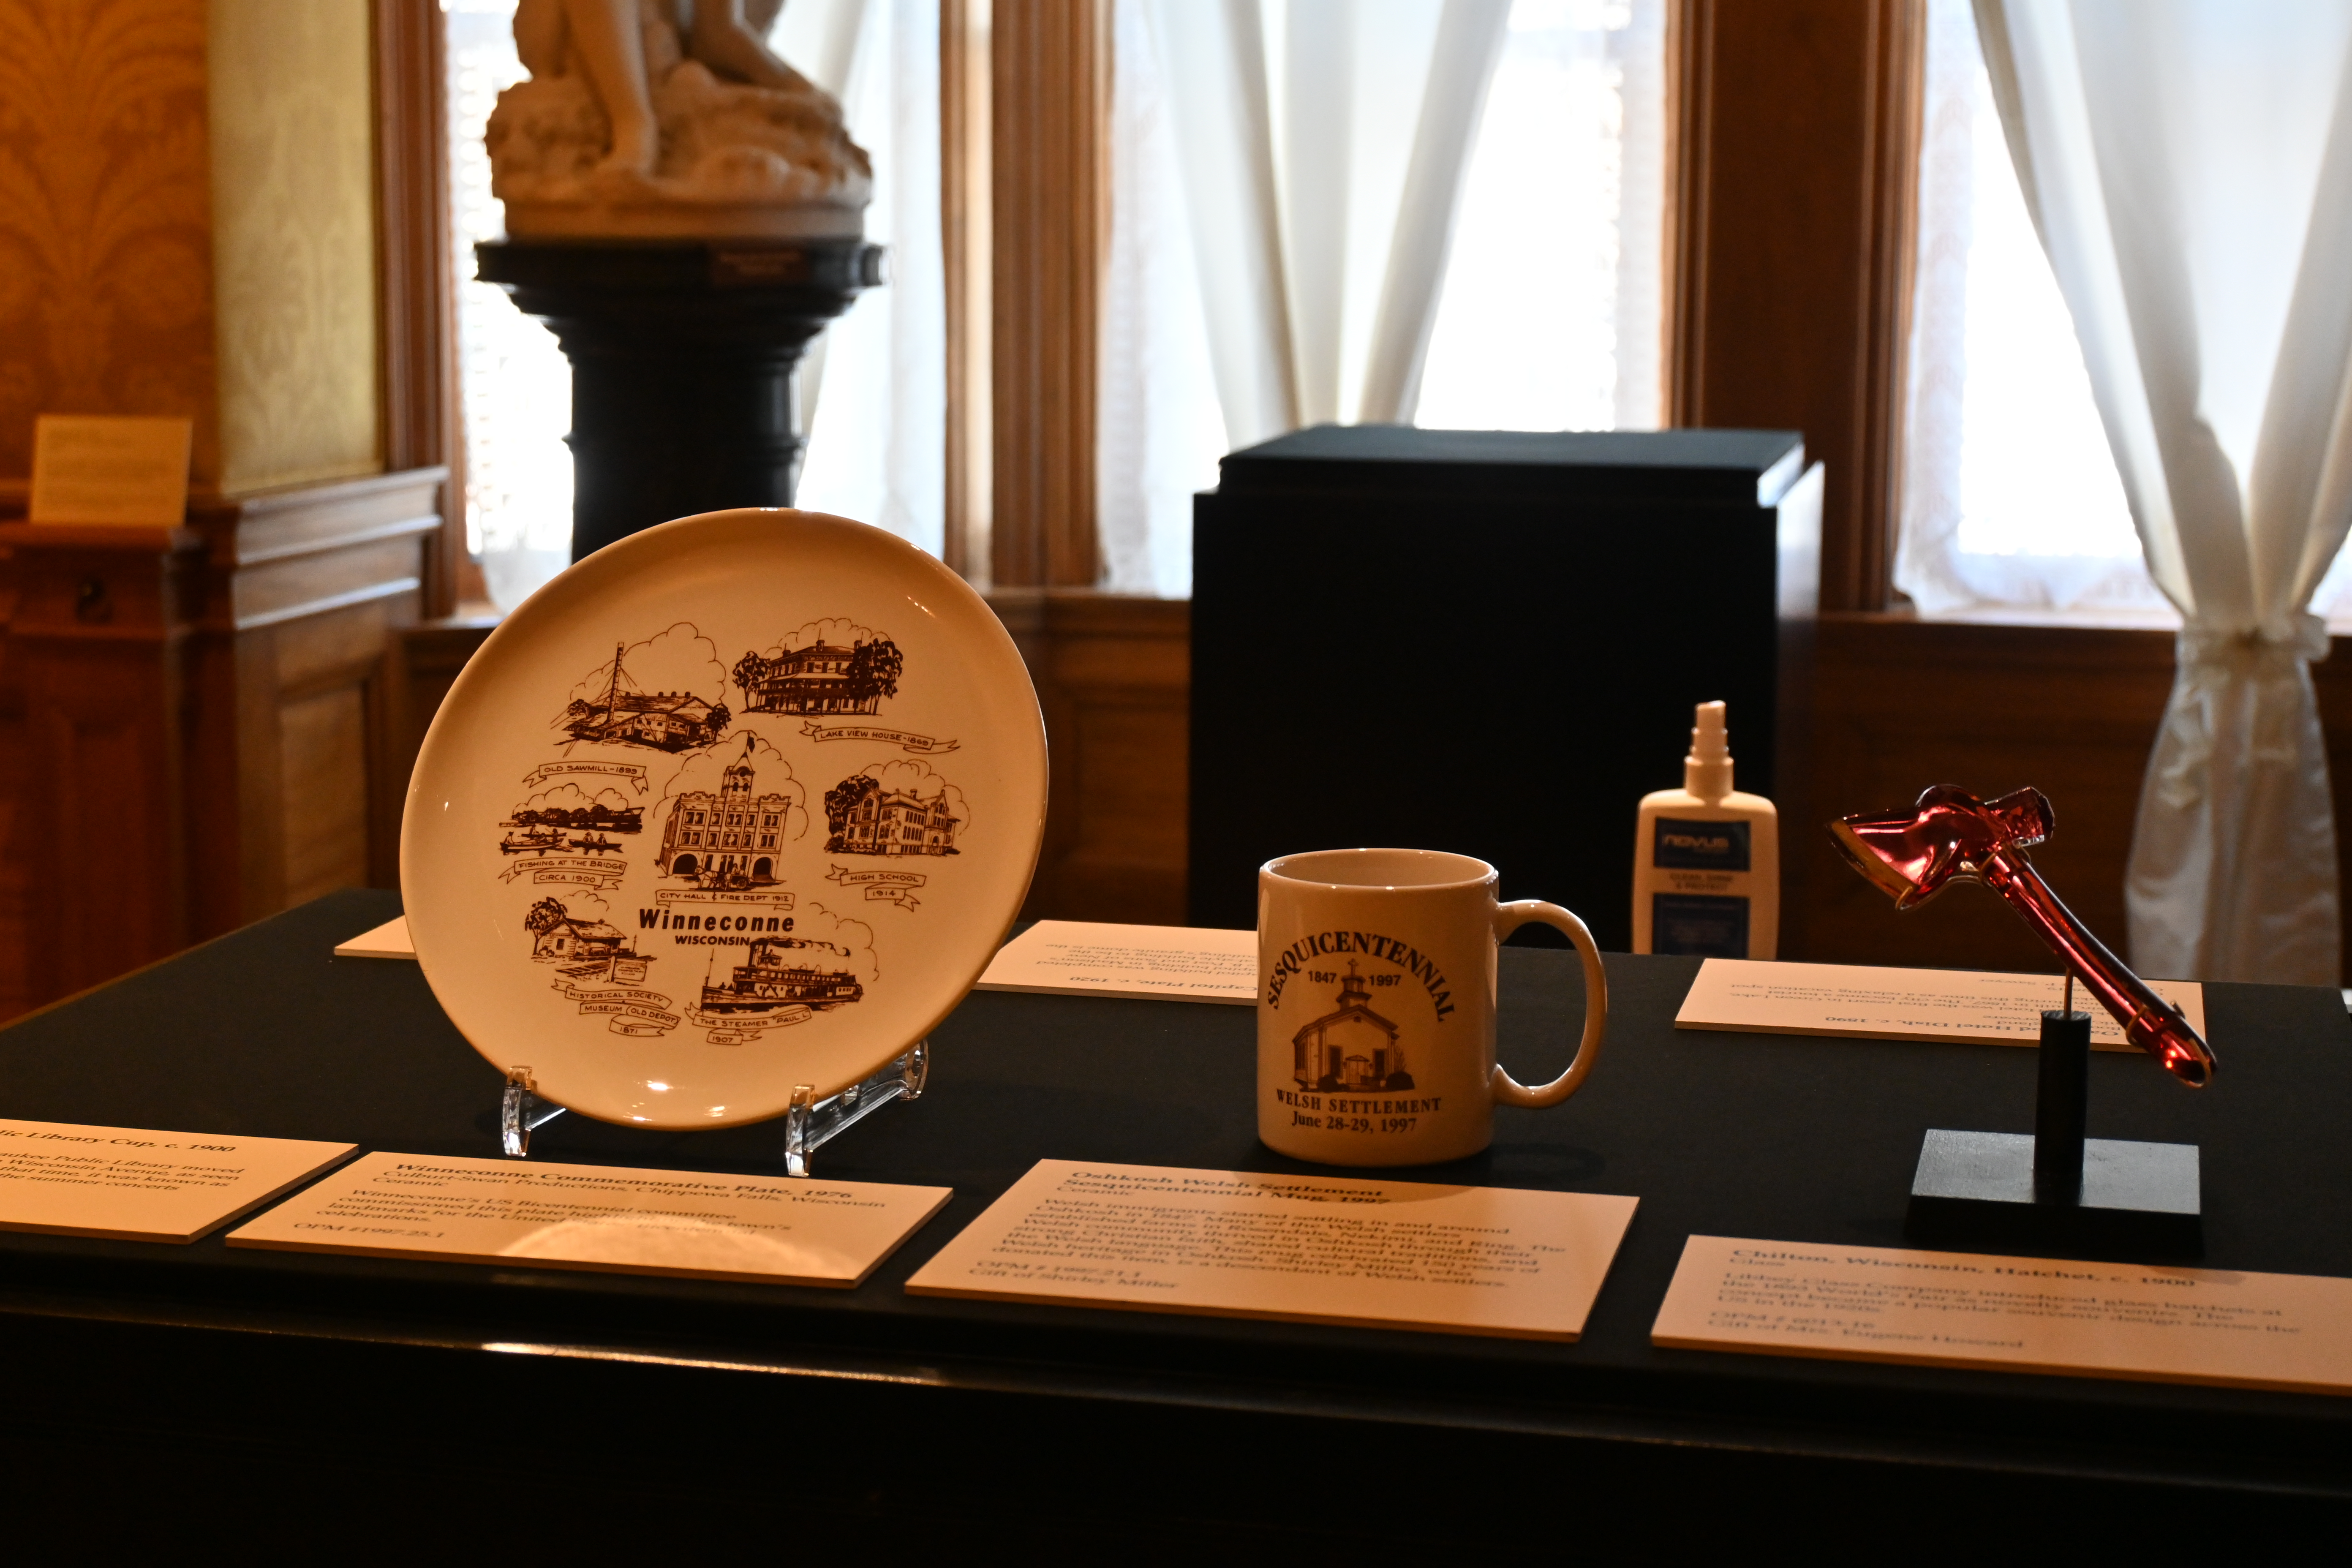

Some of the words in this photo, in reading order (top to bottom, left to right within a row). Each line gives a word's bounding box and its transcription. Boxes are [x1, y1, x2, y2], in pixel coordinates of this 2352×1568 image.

[820, 730, 844, 738] LAKE
[872, 731, 901, 741] HOUSE
[519, 860, 555, 868] FISHING
[590, 861, 625, 870] BRIDGE
[572, 875, 596, 883] 1900
[879, 874, 919, 882] SCHOOL
[640, 908, 794, 932] Winneconne
[675, 935, 750, 946] WISCONSIN
[1268, 931, 1455, 1022] SESQUICENTENNIAL
[1308, 970, 1337, 984] 1847
[1369, 974, 1402, 987] 1997
[1190, 984, 1257, 992] Capitol
[627, 991, 664, 1002] SOCIETY
[626, 1006, 647, 1016] (OLD
[648, 1011, 679, 1025] DEPOT)
[712, 1035, 734, 1043] 1907
[1277, 1088, 1321, 1111] WELSH
[1329, 1097, 1442, 1115] SETTLEMENT
[1292, 1111, 1321, 1127] June
[1326, 1116, 1374, 1134] 28-29,
[1380, 1118, 1417, 1133] 1997
[26, 1132, 105, 1143] Library
[110, 1139, 157, 1147] Cup,
[9, 1159, 96, 1170] Wisconsin
[99, 1166, 169, 1176] Avenue,
[112, 1160, 178, 1169] Library
[143, 1176, 205, 1185] known
[373, 1178, 448, 1186] Ceramic
[397, 1164, 534, 1178] Winneconne
[540, 1174, 727, 1190] Commemorative
[734, 1185, 792, 1195] Plate,
[1072, 1172, 1173, 1183] Oshkosh
[1184, 1179, 1250, 1188] Welsh
[636, 1187, 730, 1198] Chippewa
[792, 1196, 885, 1207] Wisconsin
